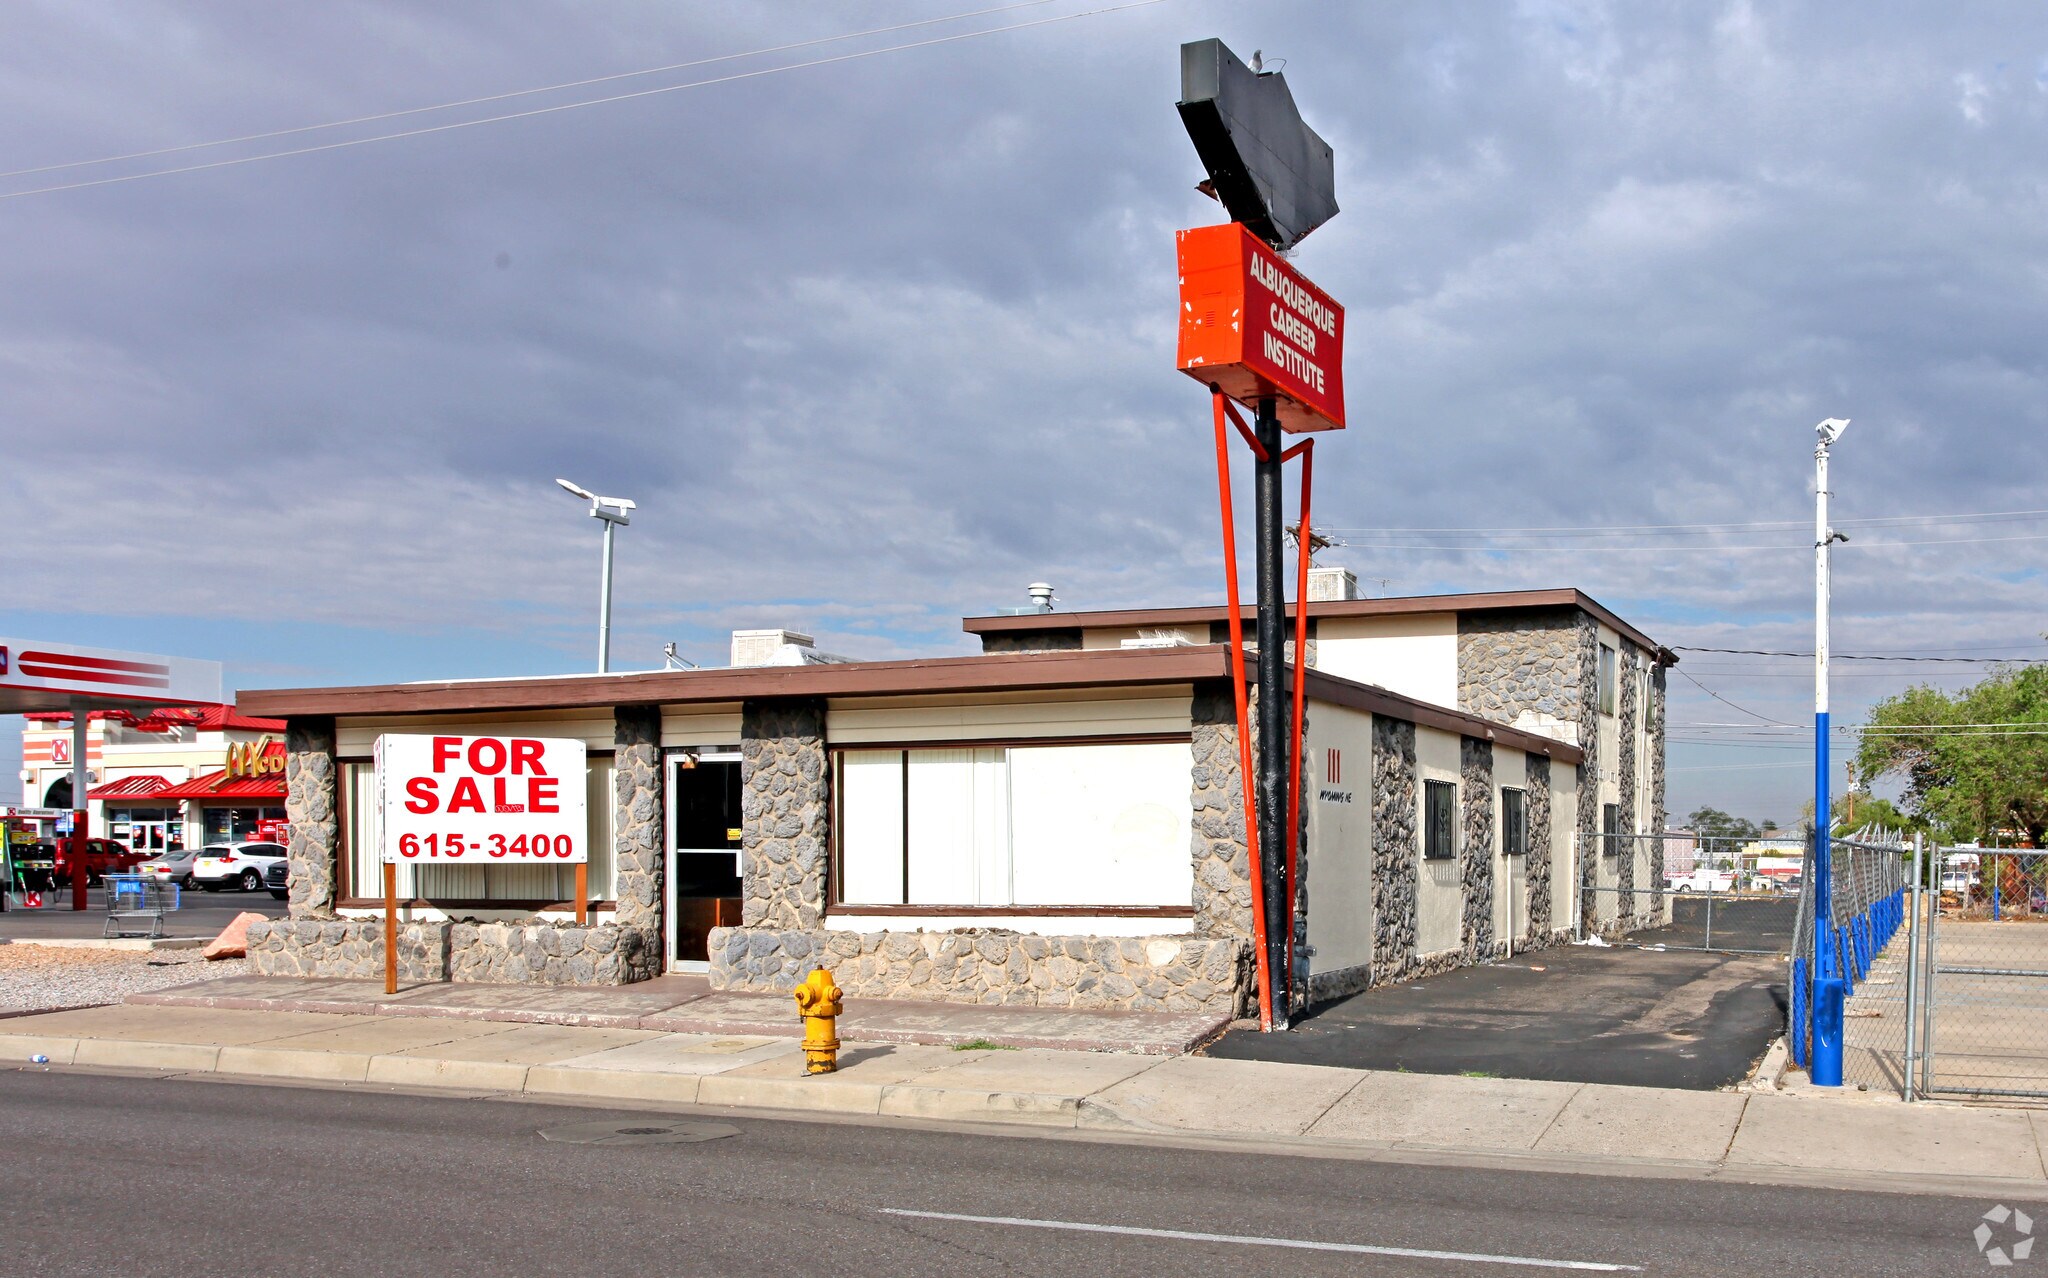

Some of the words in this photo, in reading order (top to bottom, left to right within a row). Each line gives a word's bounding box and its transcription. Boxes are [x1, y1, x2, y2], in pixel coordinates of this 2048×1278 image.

[1250, 251, 1336, 338] ALBUQUERQUE
[1269, 302, 1316, 357] CAREER
[1263, 330, 1325, 395] INSTITUTE
[432, 736, 548, 776] FOR
[404, 776, 560, 815] SALE
[1319, 789, 1344, 804] WYOMING
[1345, 791, 1352, 804] NE
[398, 832, 574, 858] 615-3400
